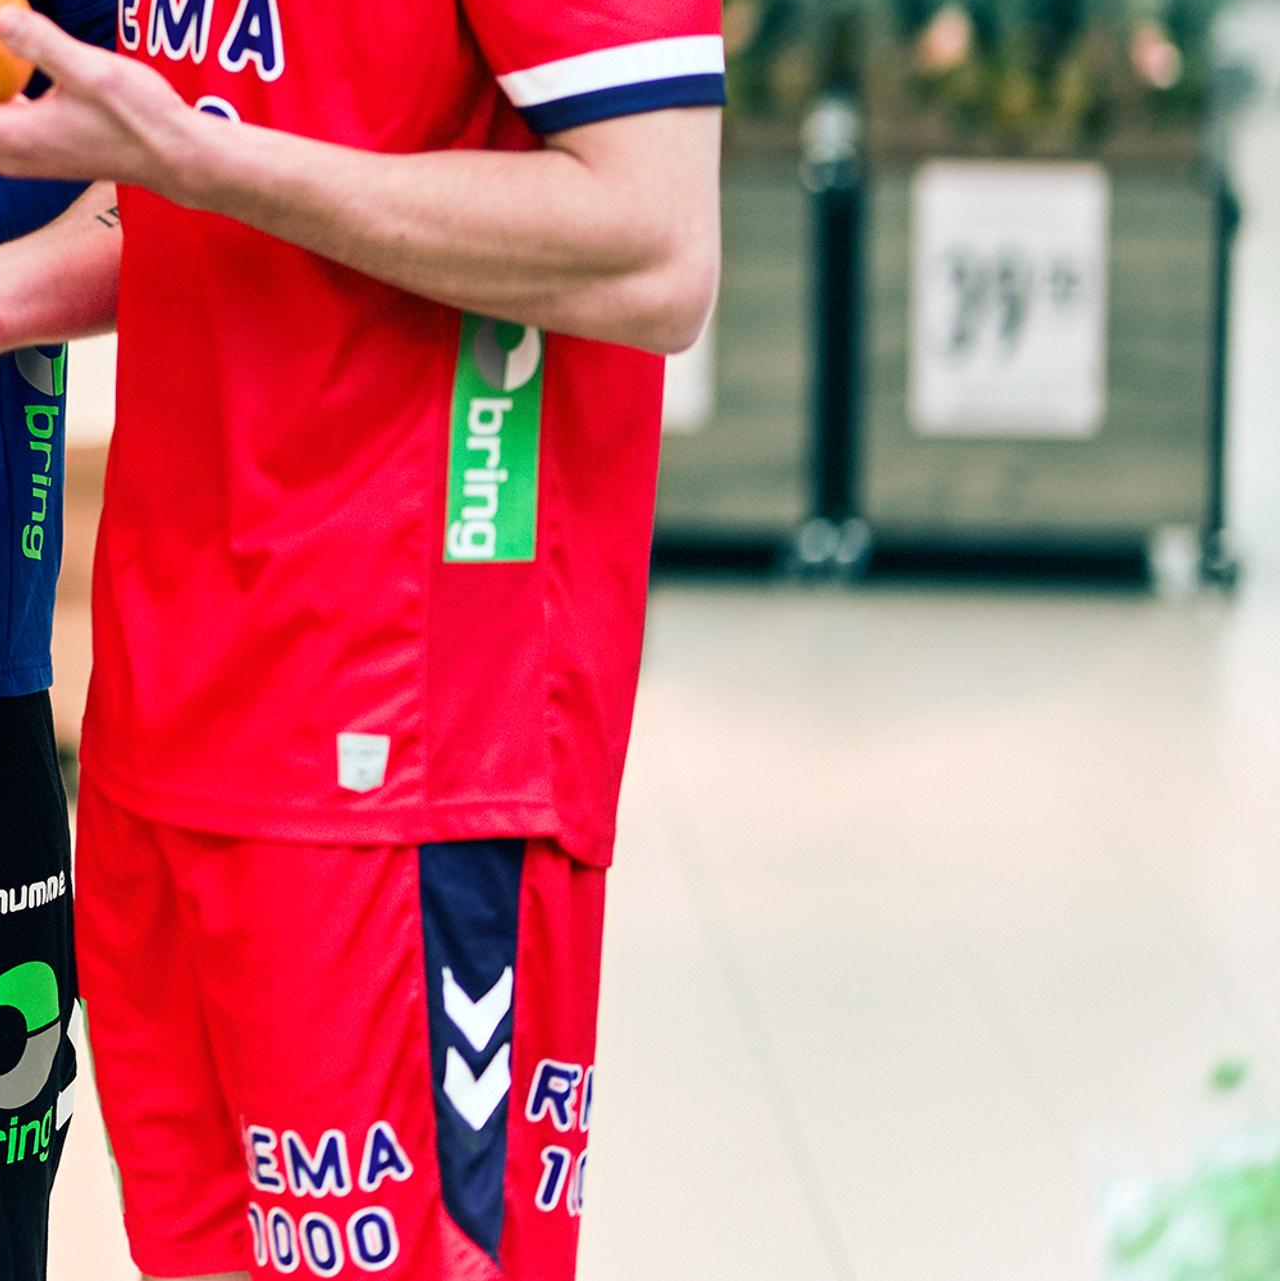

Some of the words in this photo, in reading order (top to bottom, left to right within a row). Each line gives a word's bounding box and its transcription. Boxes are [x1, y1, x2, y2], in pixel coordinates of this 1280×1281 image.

[22, 404, 59, 560] bring
[446, 397, 513, 558] bring
[244, 1120, 413, 1198] EMA
